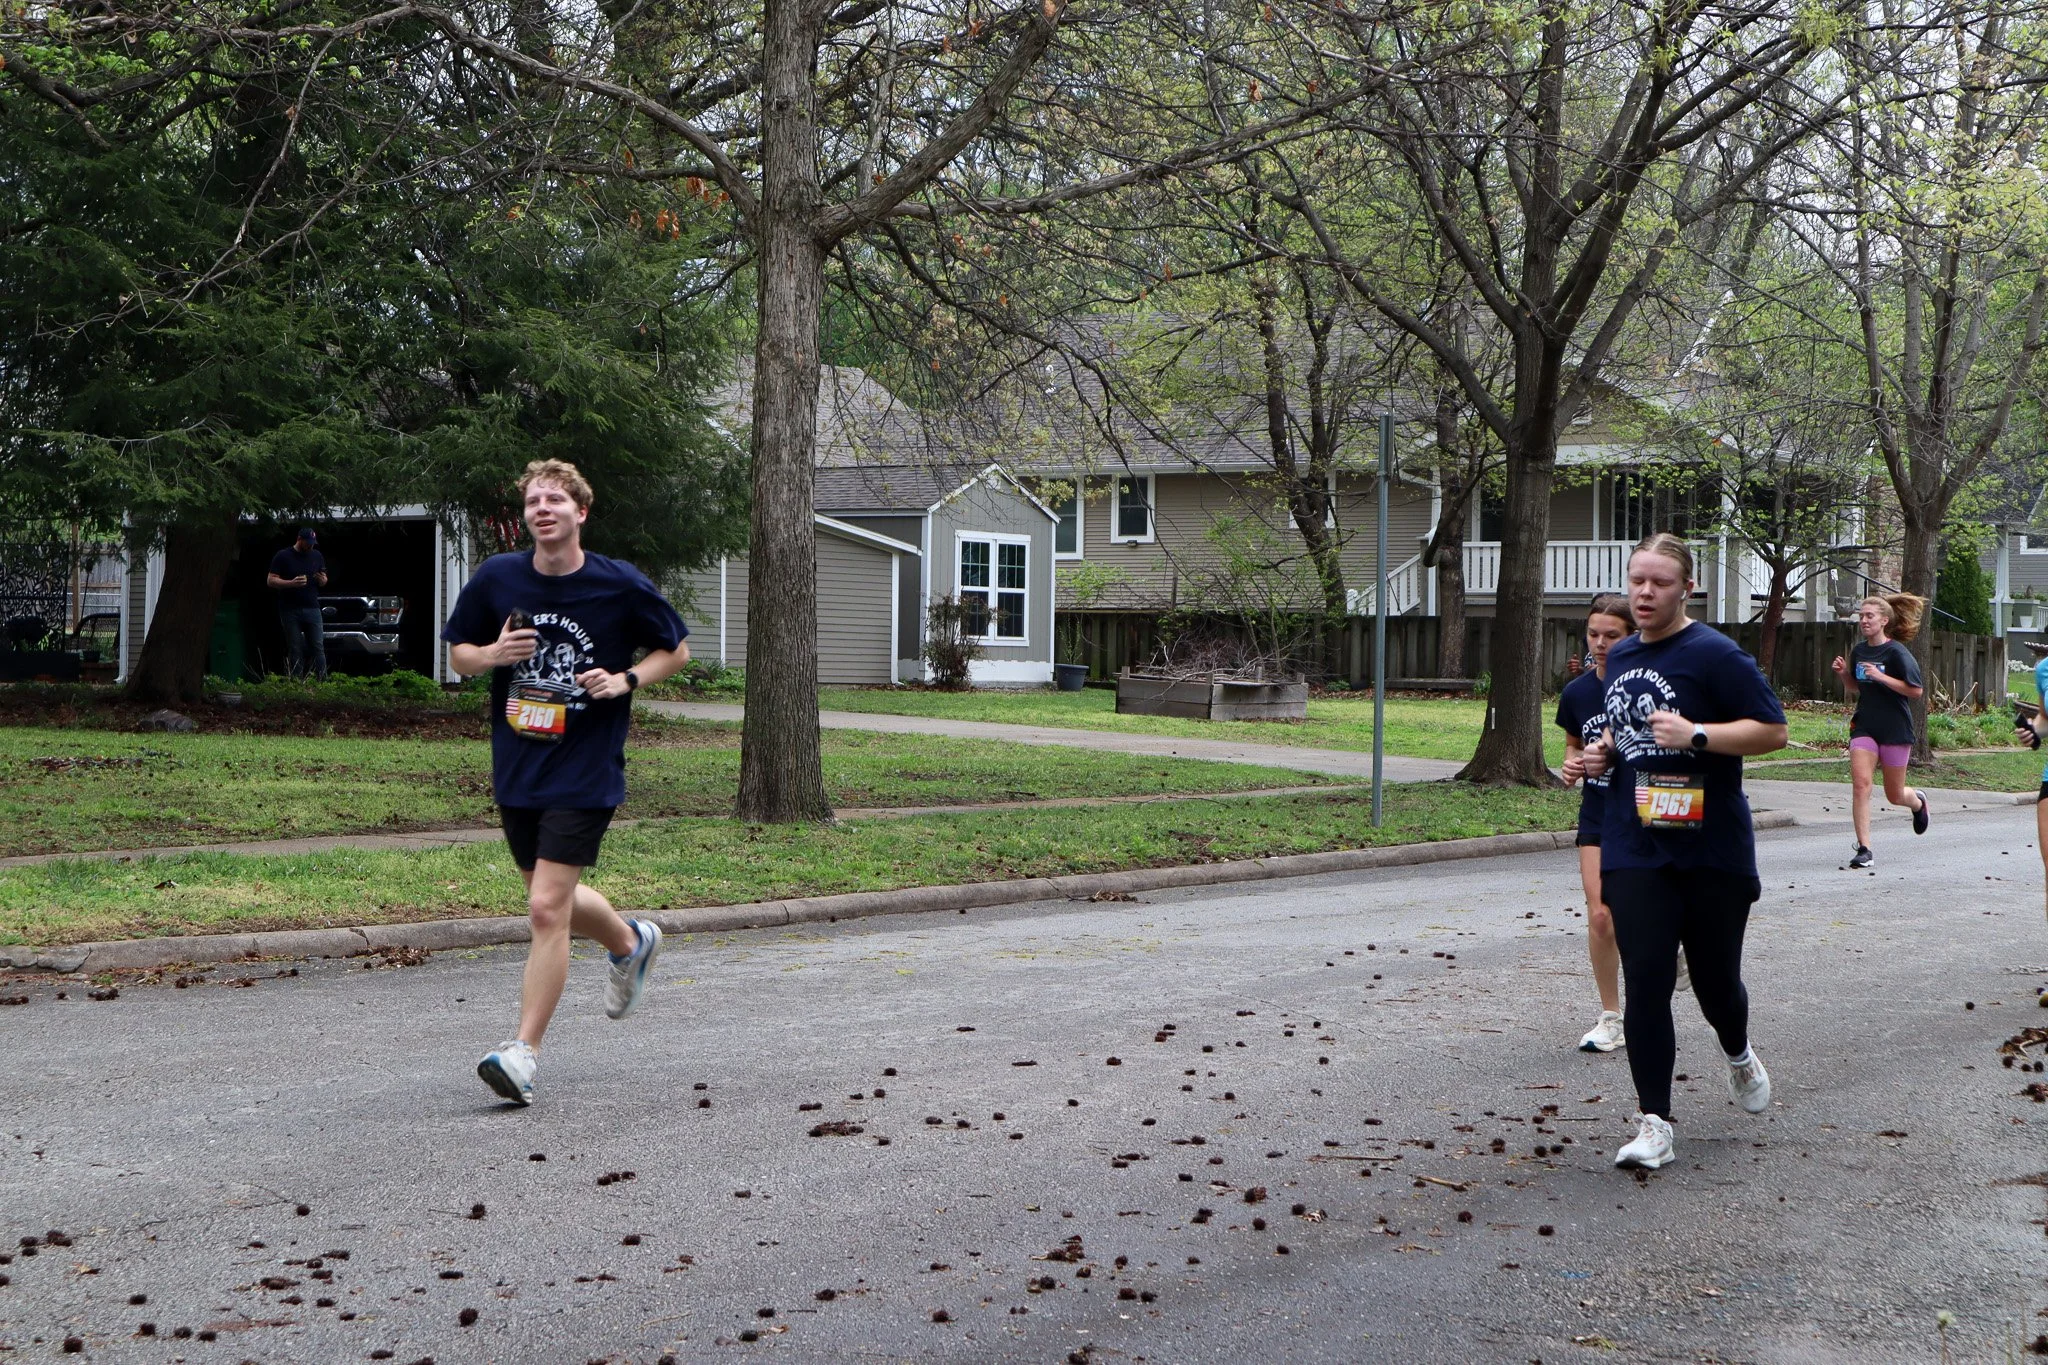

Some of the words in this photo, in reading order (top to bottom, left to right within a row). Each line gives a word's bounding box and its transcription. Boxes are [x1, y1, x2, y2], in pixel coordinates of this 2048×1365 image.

[533, 613, 558, 626] ER'S
[559, 616, 594, 651] HOUSE
[1643, 668, 1676, 701] HOUSE
[518, 704, 556, 729] 2160
[1582, 713, 1607, 739] OTTER
[1649, 791, 1693, 816] 1963
